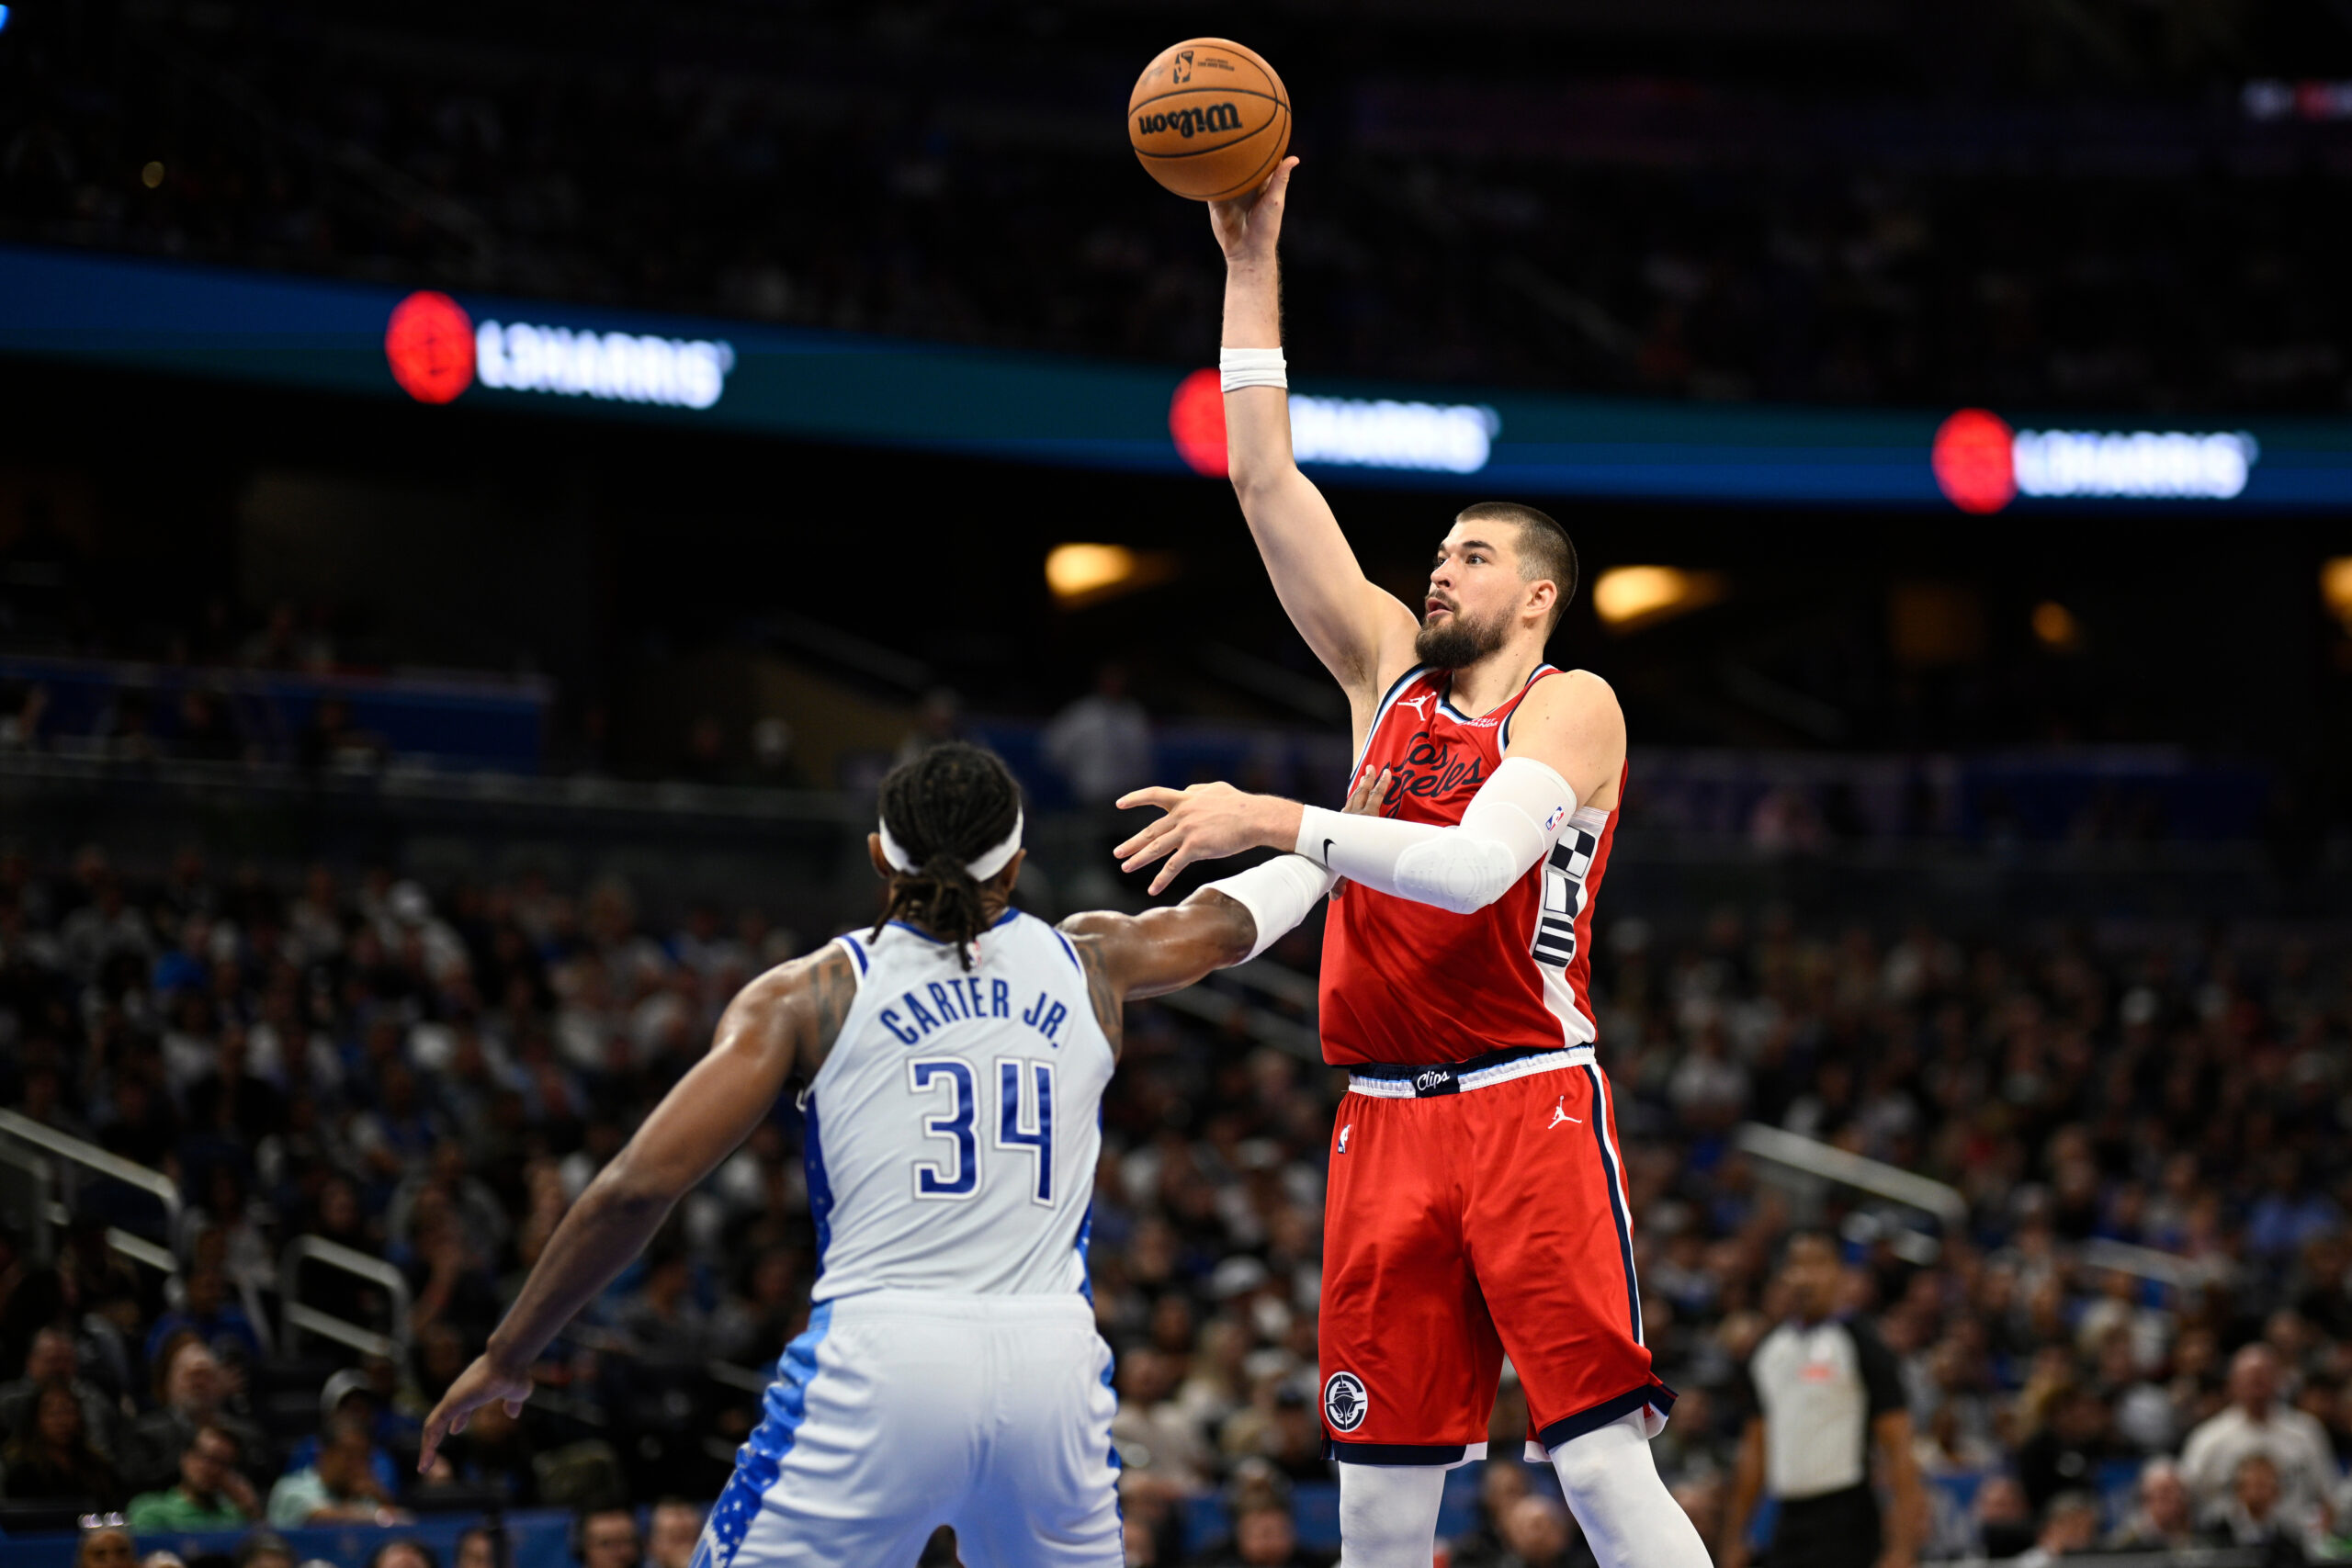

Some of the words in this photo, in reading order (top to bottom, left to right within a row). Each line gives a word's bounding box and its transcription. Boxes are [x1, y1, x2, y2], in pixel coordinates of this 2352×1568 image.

[1138, 102, 1243, 138] Wilson
[879, 976, 1010, 1046] CARTER
[1023, 991, 1068, 1048] JR.
[1417, 1070, 1451, 1091] Clips
[907, 1056, 1056, 1209] 34
